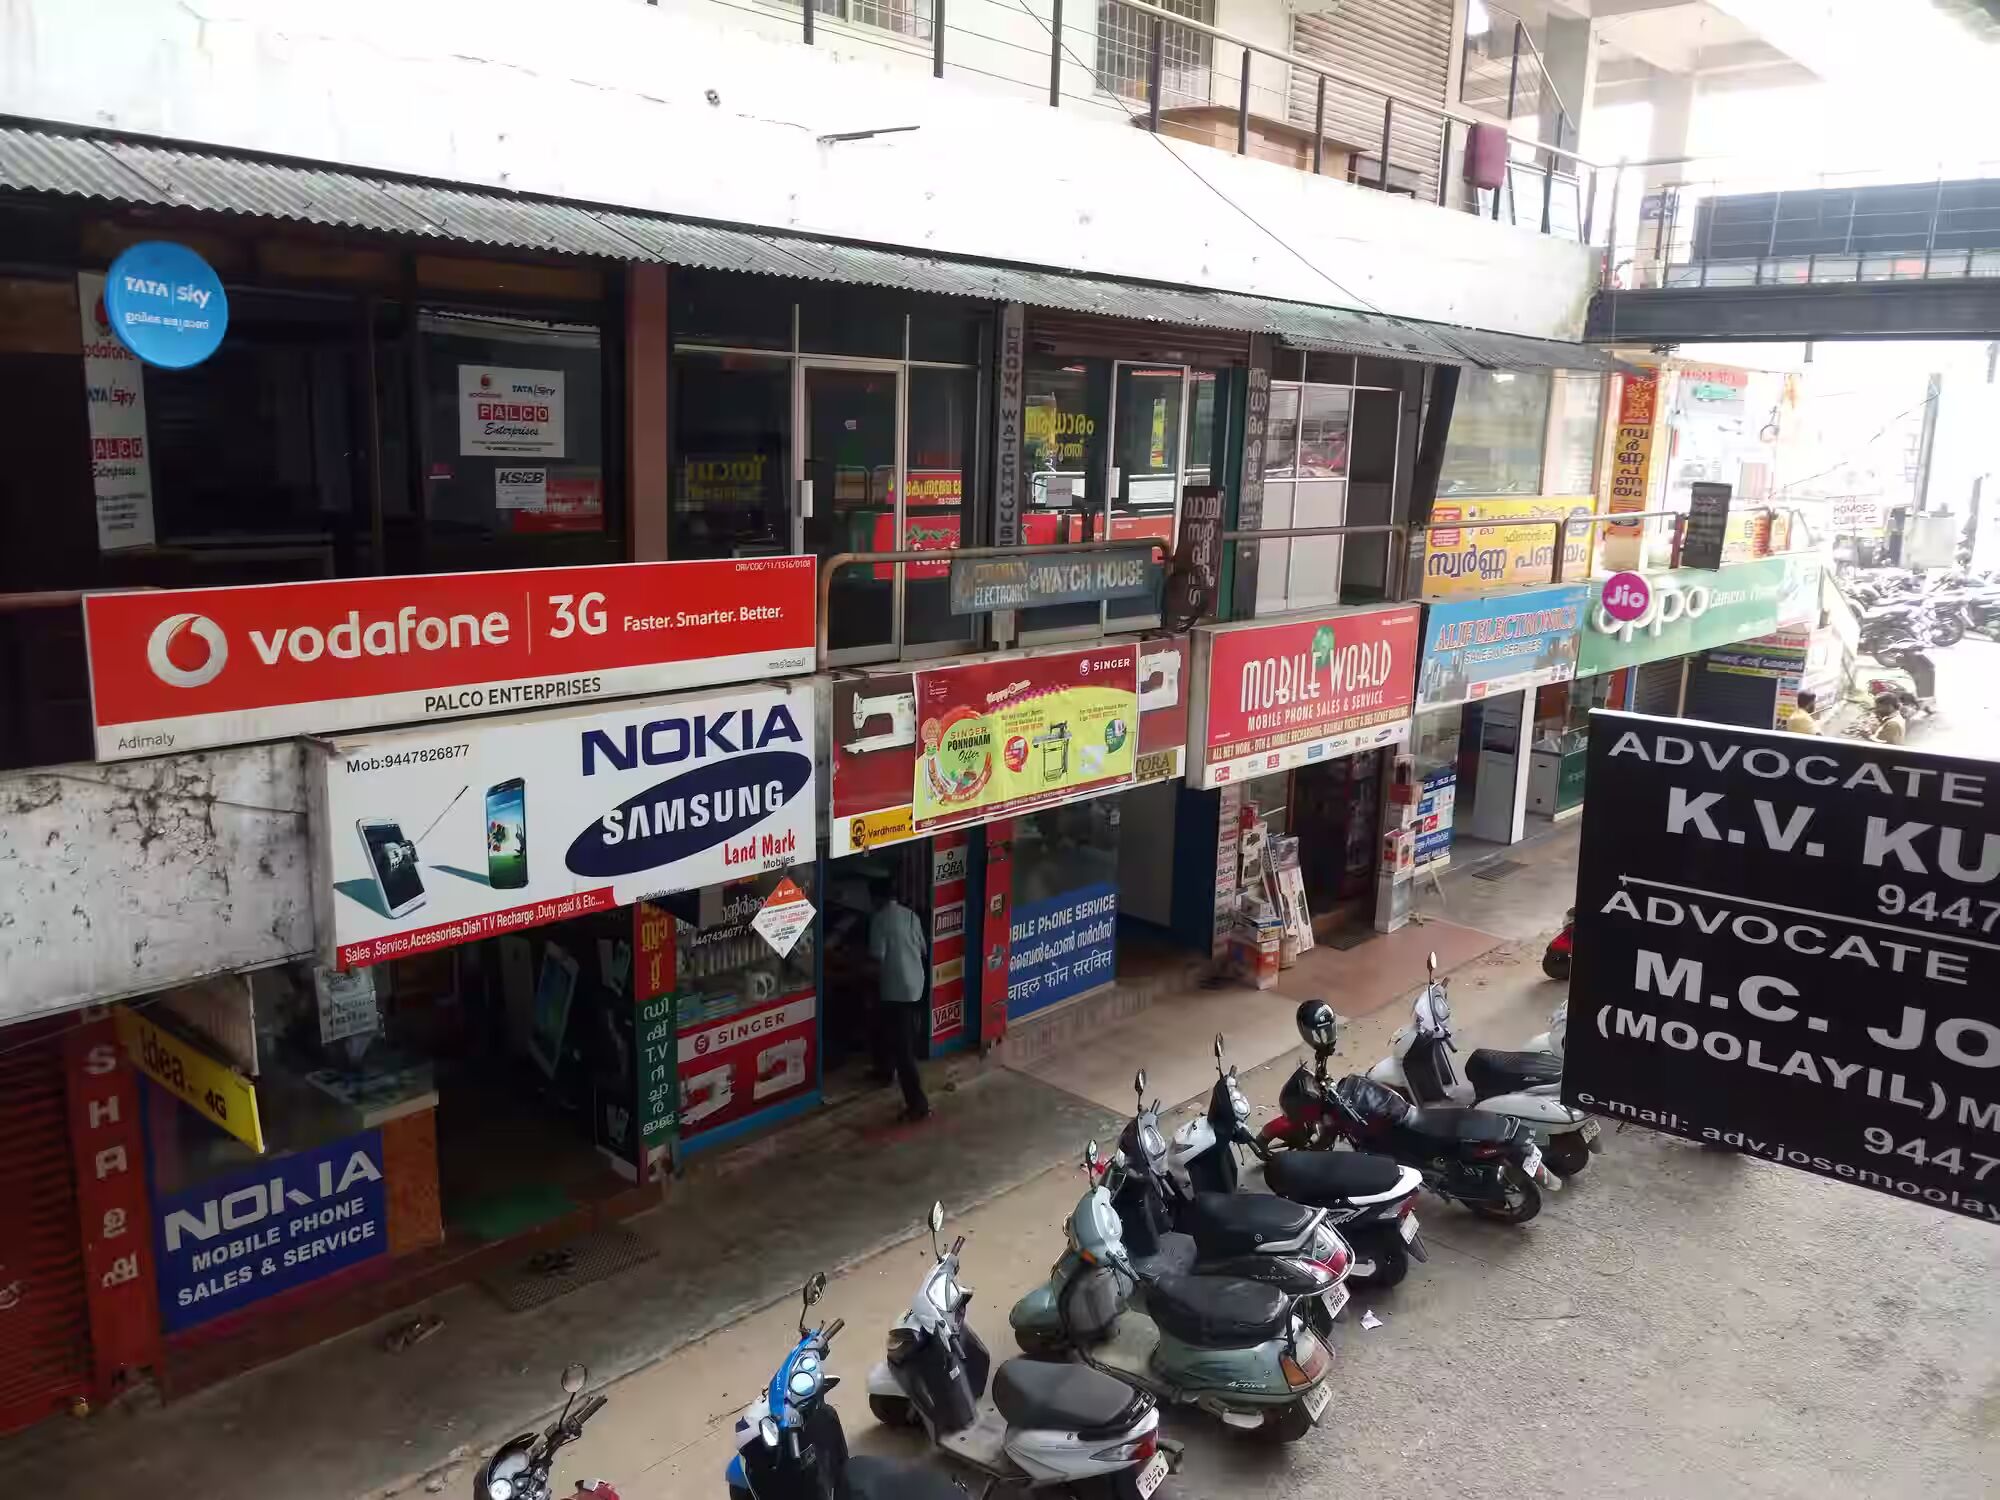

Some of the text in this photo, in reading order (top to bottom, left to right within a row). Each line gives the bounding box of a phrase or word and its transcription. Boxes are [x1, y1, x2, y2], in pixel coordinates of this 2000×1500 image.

[125, 277, 169, 298] TATA
[512, 385, 533, 394] TATA
[1096, 559, 1144, 590] HOUSE
[548, 591, 608, 639] 3G
[1606, 584, 1645, 608] Jio
[248, 606, 510, 665] vodafone
[623, 604, 784, 632] Faster. Smarter. Better.
[1434, 606, 1577, 652] ALIF ELECTRONICS
[1093, 658, 1131, 672] SINGER
[1240, 639, 1393, 713] MOBILE WORLD
[425, 677, 601, 713] PALCO ENTERPRISES
[1248, 689, 1384, 733] MOBILE PHONE SALES & SERVICE
[117, 731, 176, 751] Adimaly
[581, 703, 804, 777] NOKIA
[950, 727, 988, 741] SINGER
[346, 743, 471, 775] Mob:9447826877
[1608, 731, 1987, 807] ADVOCATE
[601, 779, 785, 846] SAMSUNG
[868, 823, 906, 839] Vardhman
[1666, 786, 1825, 857] K.V.
[723, 828, 796, 866] Land Mark
[936, 860, 964, 875] TORA
[1075, 893, 1115, 921] SERVICE
[345, 946, 371, 964] Sales
[497, 907, 535, 928] Recharge
[558, 895, 576, 916] paid
[576, 894, 583, 908] &
[1600, 890, 1970, 985] ADVOCATE
[1634, 948, 1829, 1033] M.C.
[718, 1011, 786, 1045] SINGER
[1596, 1004, 1948, 1121] (MOOLAYIL)
[1577, 1092, 1690, 1133] e-mail:
[164, 1150, 384, 1252] NOKIA
[192, 1197, 366, 1273] MOBILE PHONE
[177, 1220, 376, 1306] SALES & SERVICE
[1227, 1380, 1267, 1390] Activa
